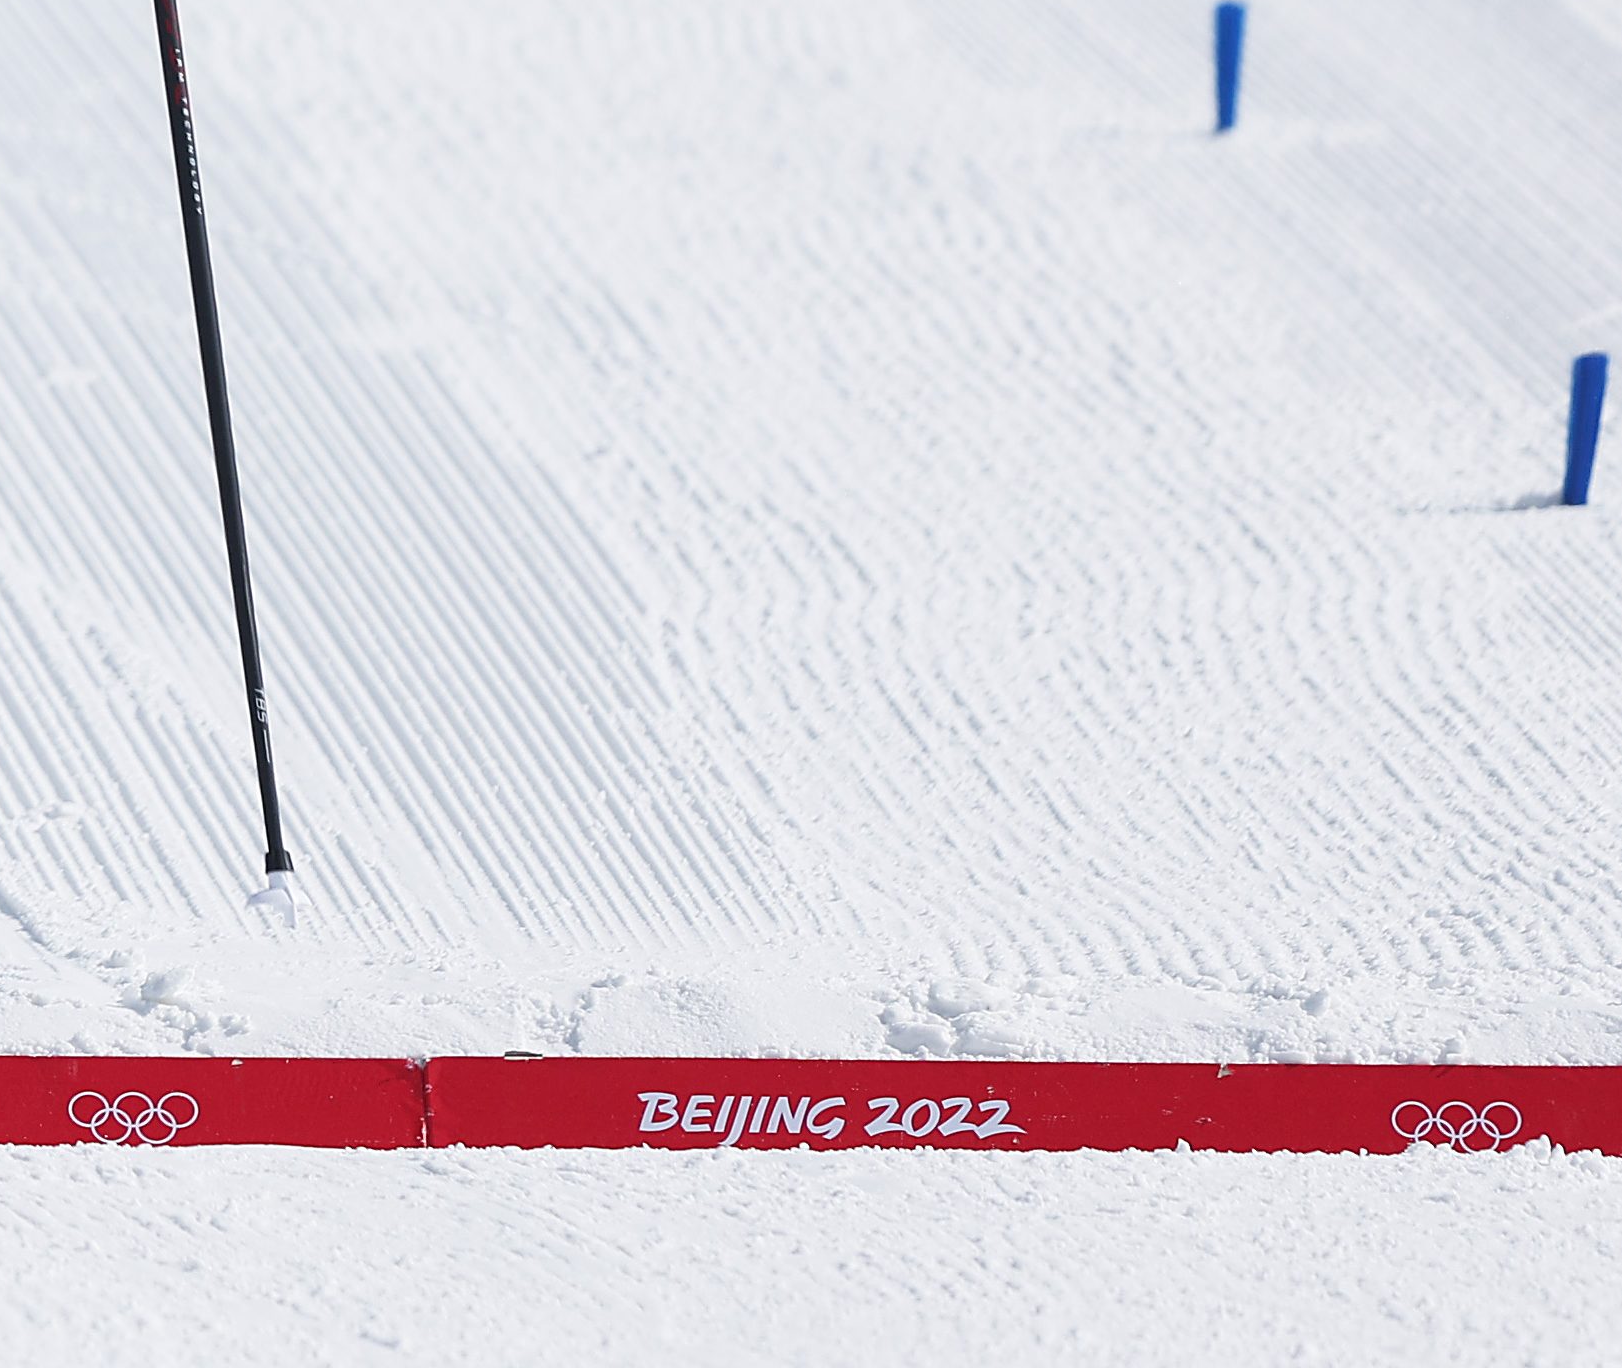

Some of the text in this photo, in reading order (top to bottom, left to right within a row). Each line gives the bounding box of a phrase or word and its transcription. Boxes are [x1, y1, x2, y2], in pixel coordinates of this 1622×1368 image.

[181, 96, 203, 215] TECHNOLOGY
[638, 1092, 1027, 1144] BEIJING 2022
